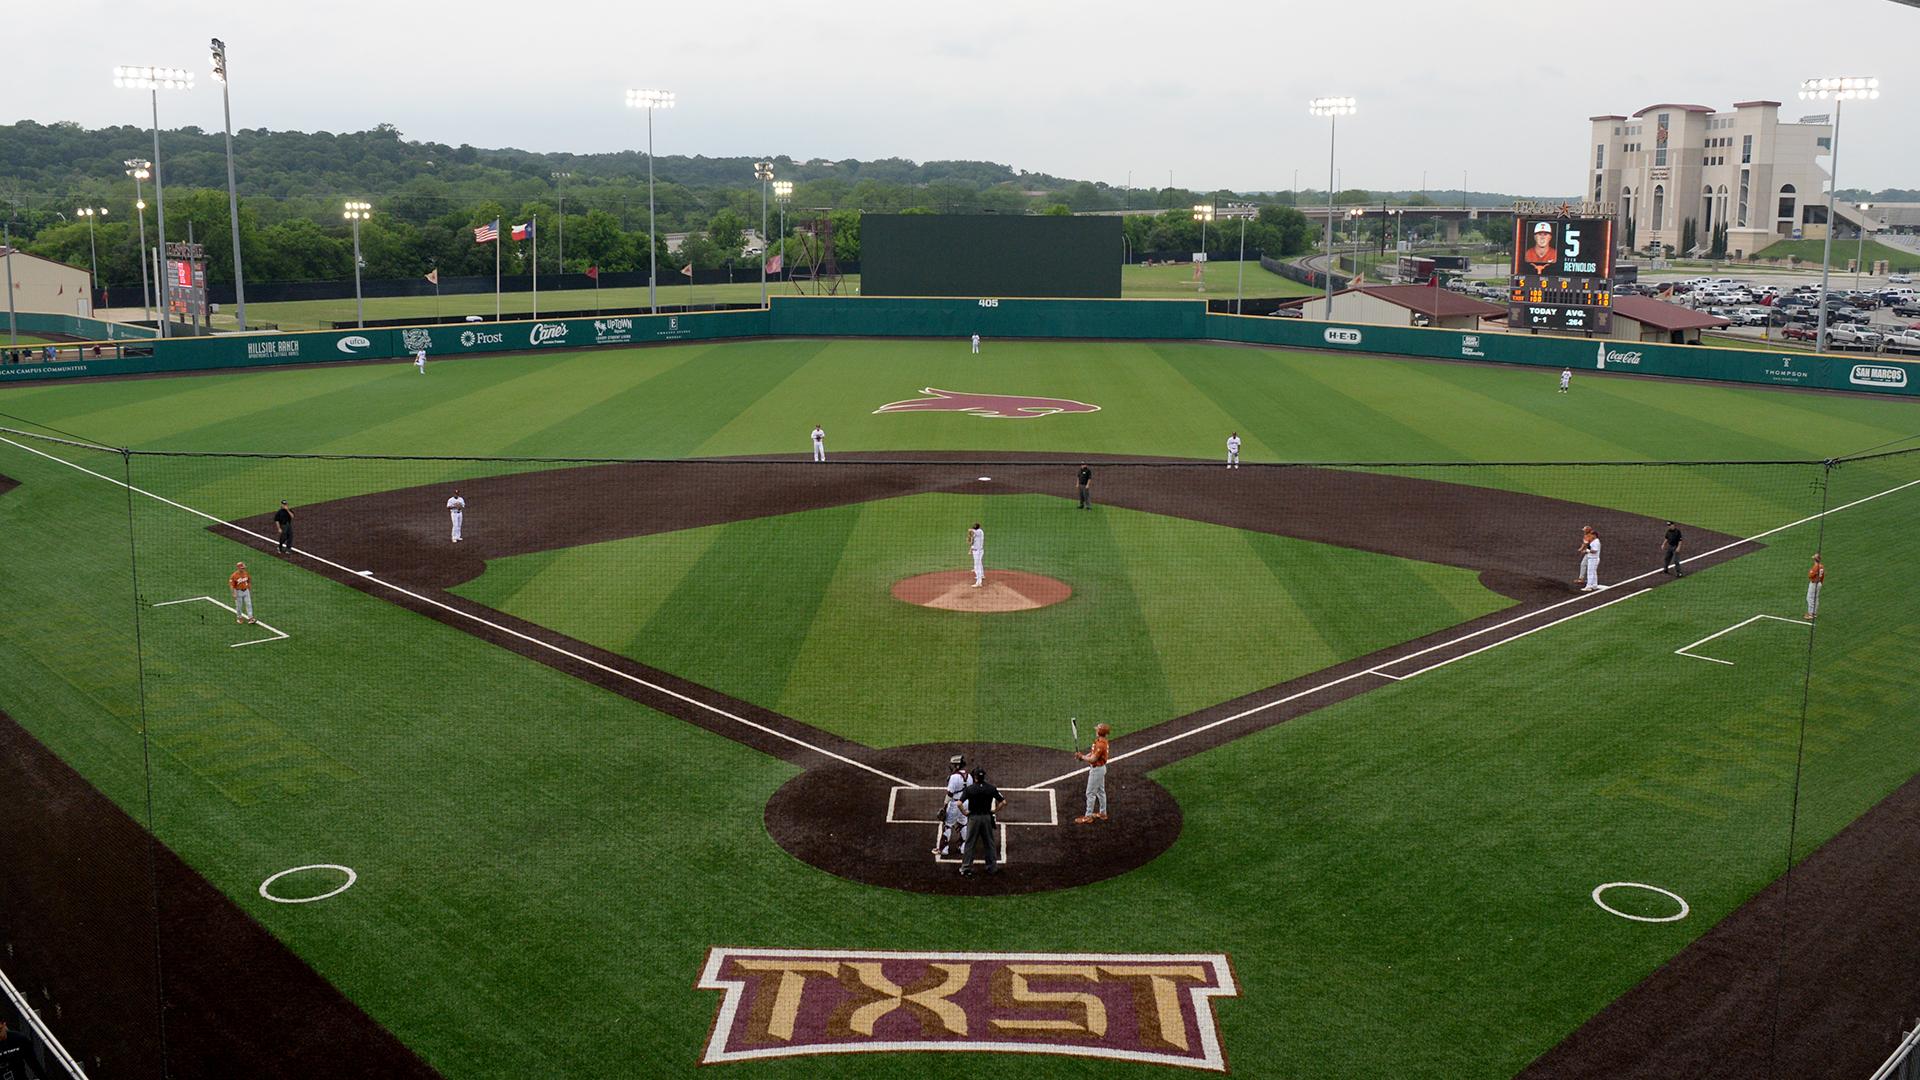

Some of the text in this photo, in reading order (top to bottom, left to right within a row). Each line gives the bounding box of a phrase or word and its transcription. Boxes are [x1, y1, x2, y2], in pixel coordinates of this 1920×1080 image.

[1512, 200, 1617, 215] TEXAS STATE
[1564, 230, 1581, 257] 5
[1563, 262, 1597, 273] REYNOLDS
[978, 299, 999, 308] 405
[1529, 307, 1557, 315] TODAY
[1565, 309, 1586, 317] AVG.
[606, 318, 633, 330] UPTOWN
[476, 332, 503, 344] Frost
[529, 322, 569, 345] Cane's
[247, 340, 299, 354] HILLSIDE RANCH
[42, 365, 87, 373] COMMUNITIES
[1765, 369, 1808, 377] THOMPSON
[1855, 367, 1870, 377] SAN
[1871, 368, 1902, 380] MARCOS
[732, 958, 1208, 1052] TXST
